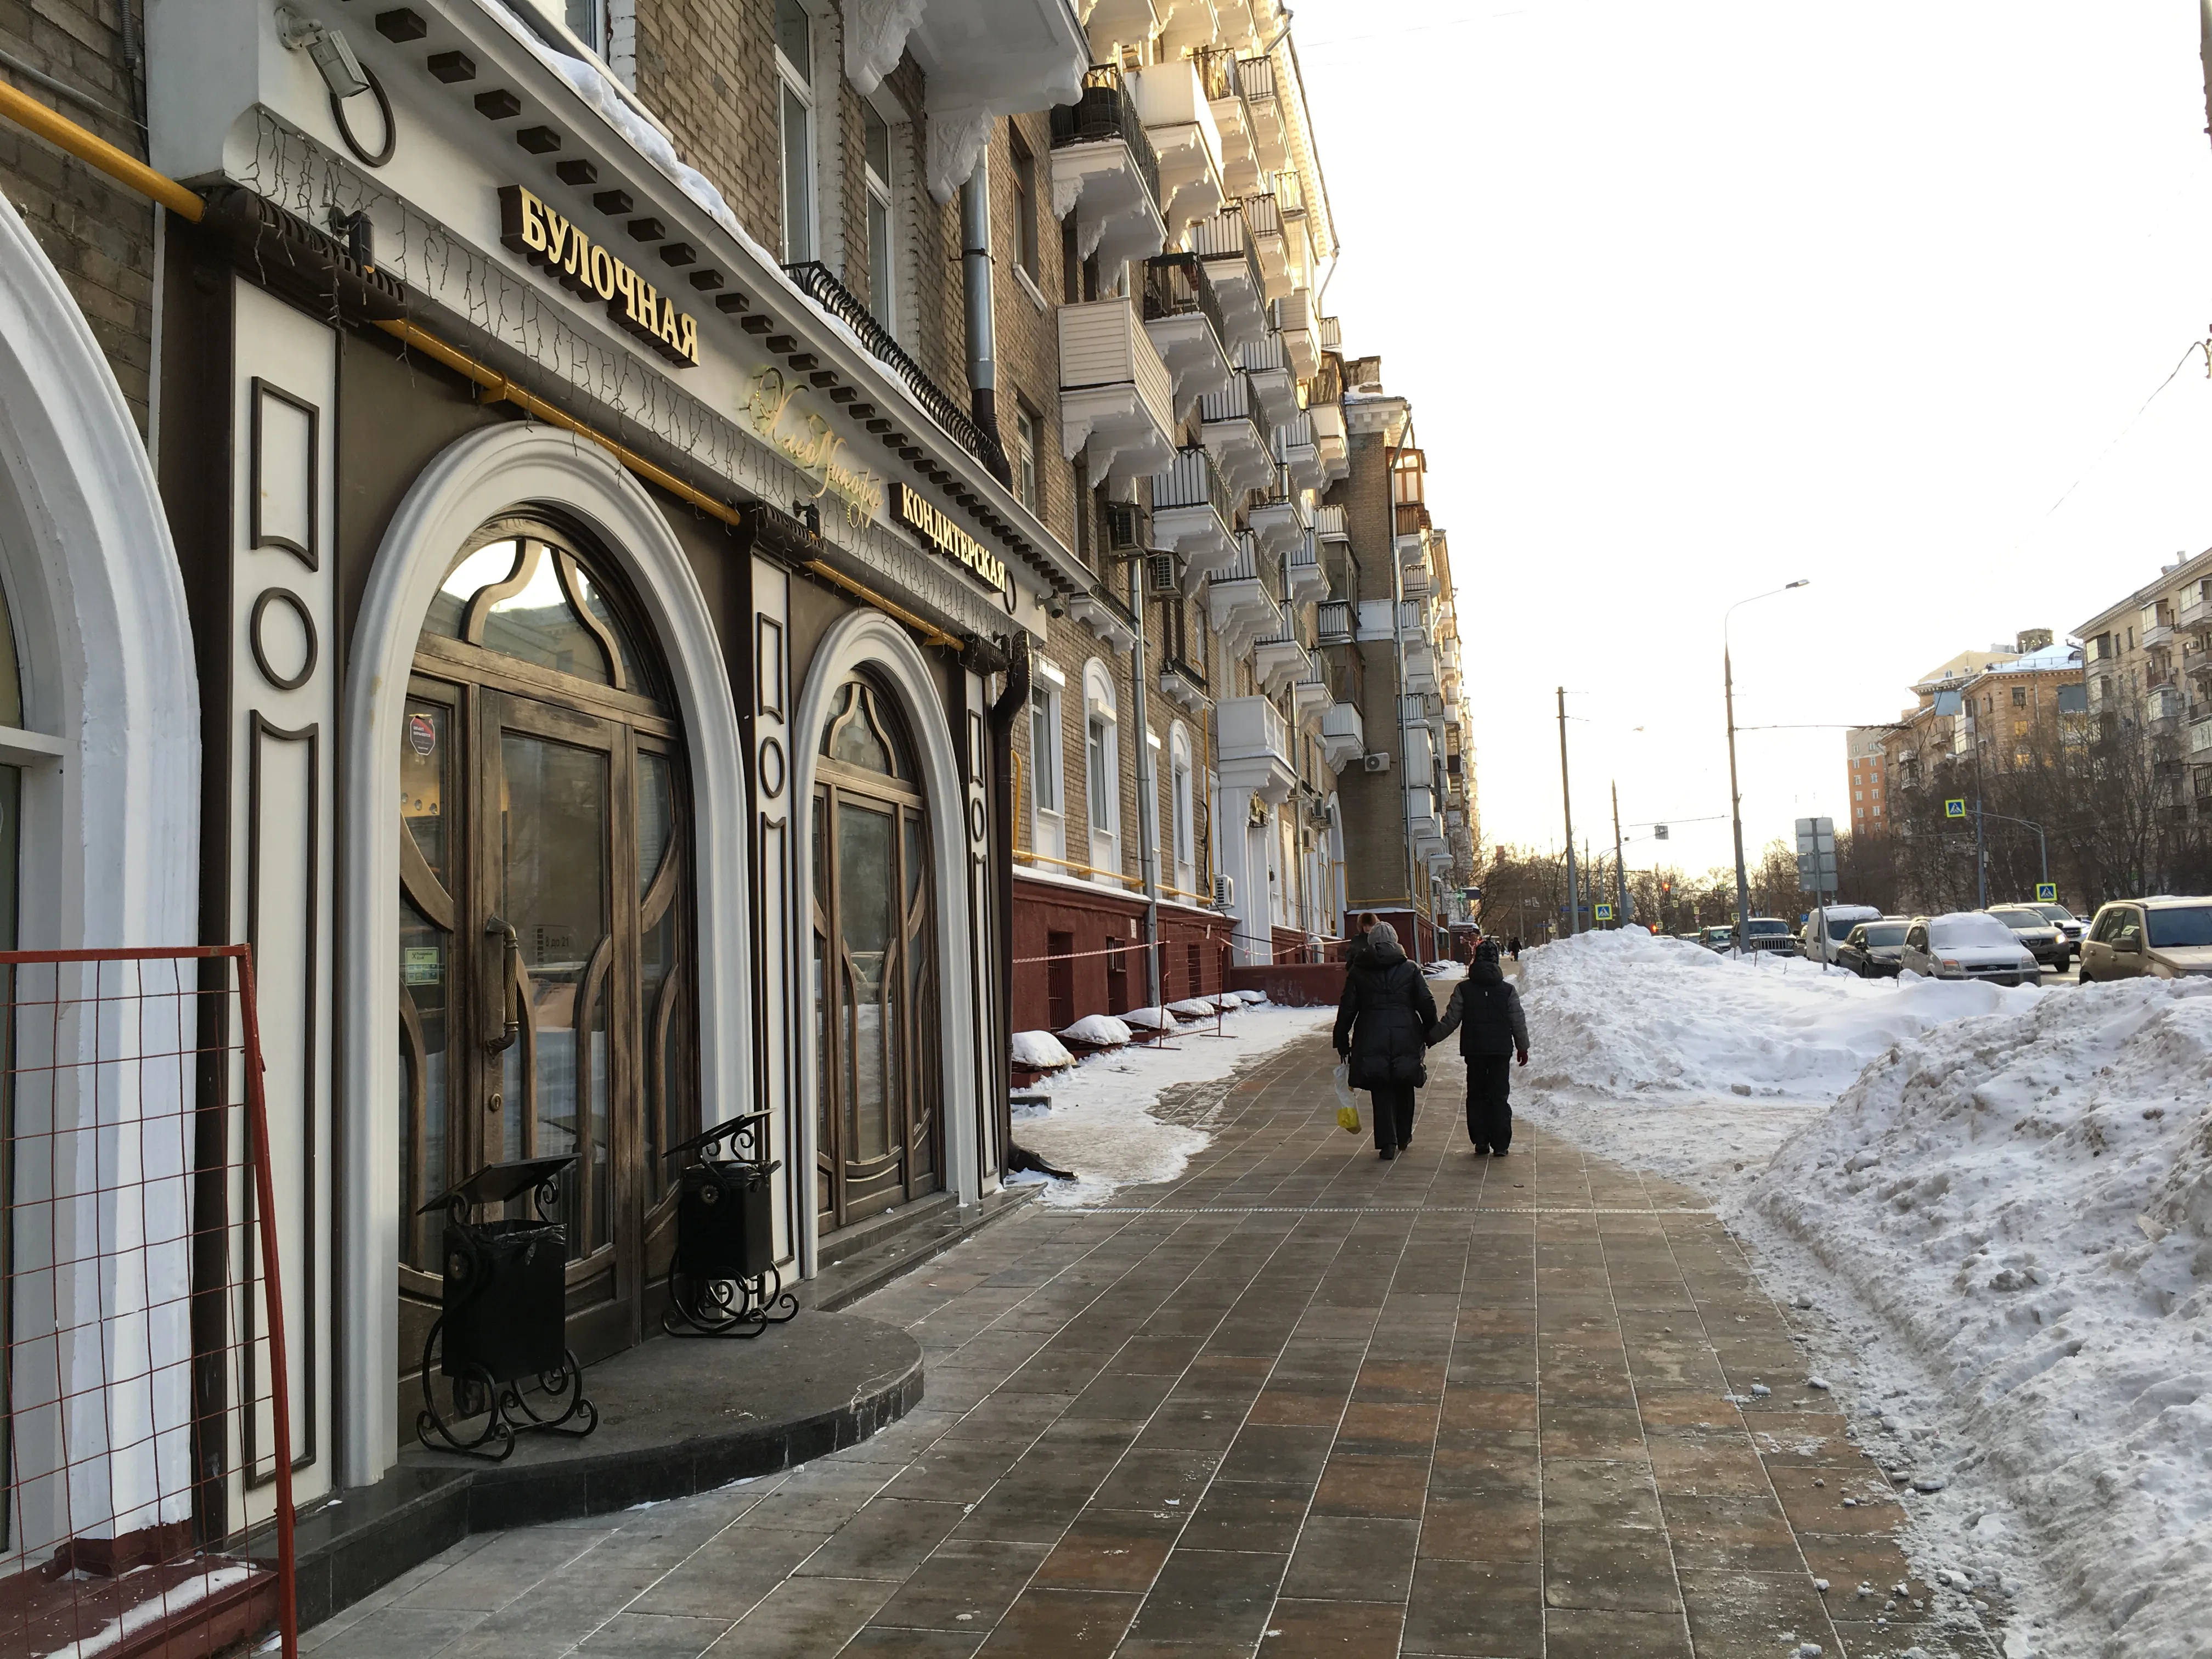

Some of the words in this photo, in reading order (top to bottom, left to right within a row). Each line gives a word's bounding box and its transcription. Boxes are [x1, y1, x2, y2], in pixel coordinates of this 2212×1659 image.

[519, 184, 700, 366] БУЛОЧНАЯ
[901, 482, 1006, 592] КОНДИТЕРСКАЯ
[561, 936, 569, 947] 21
